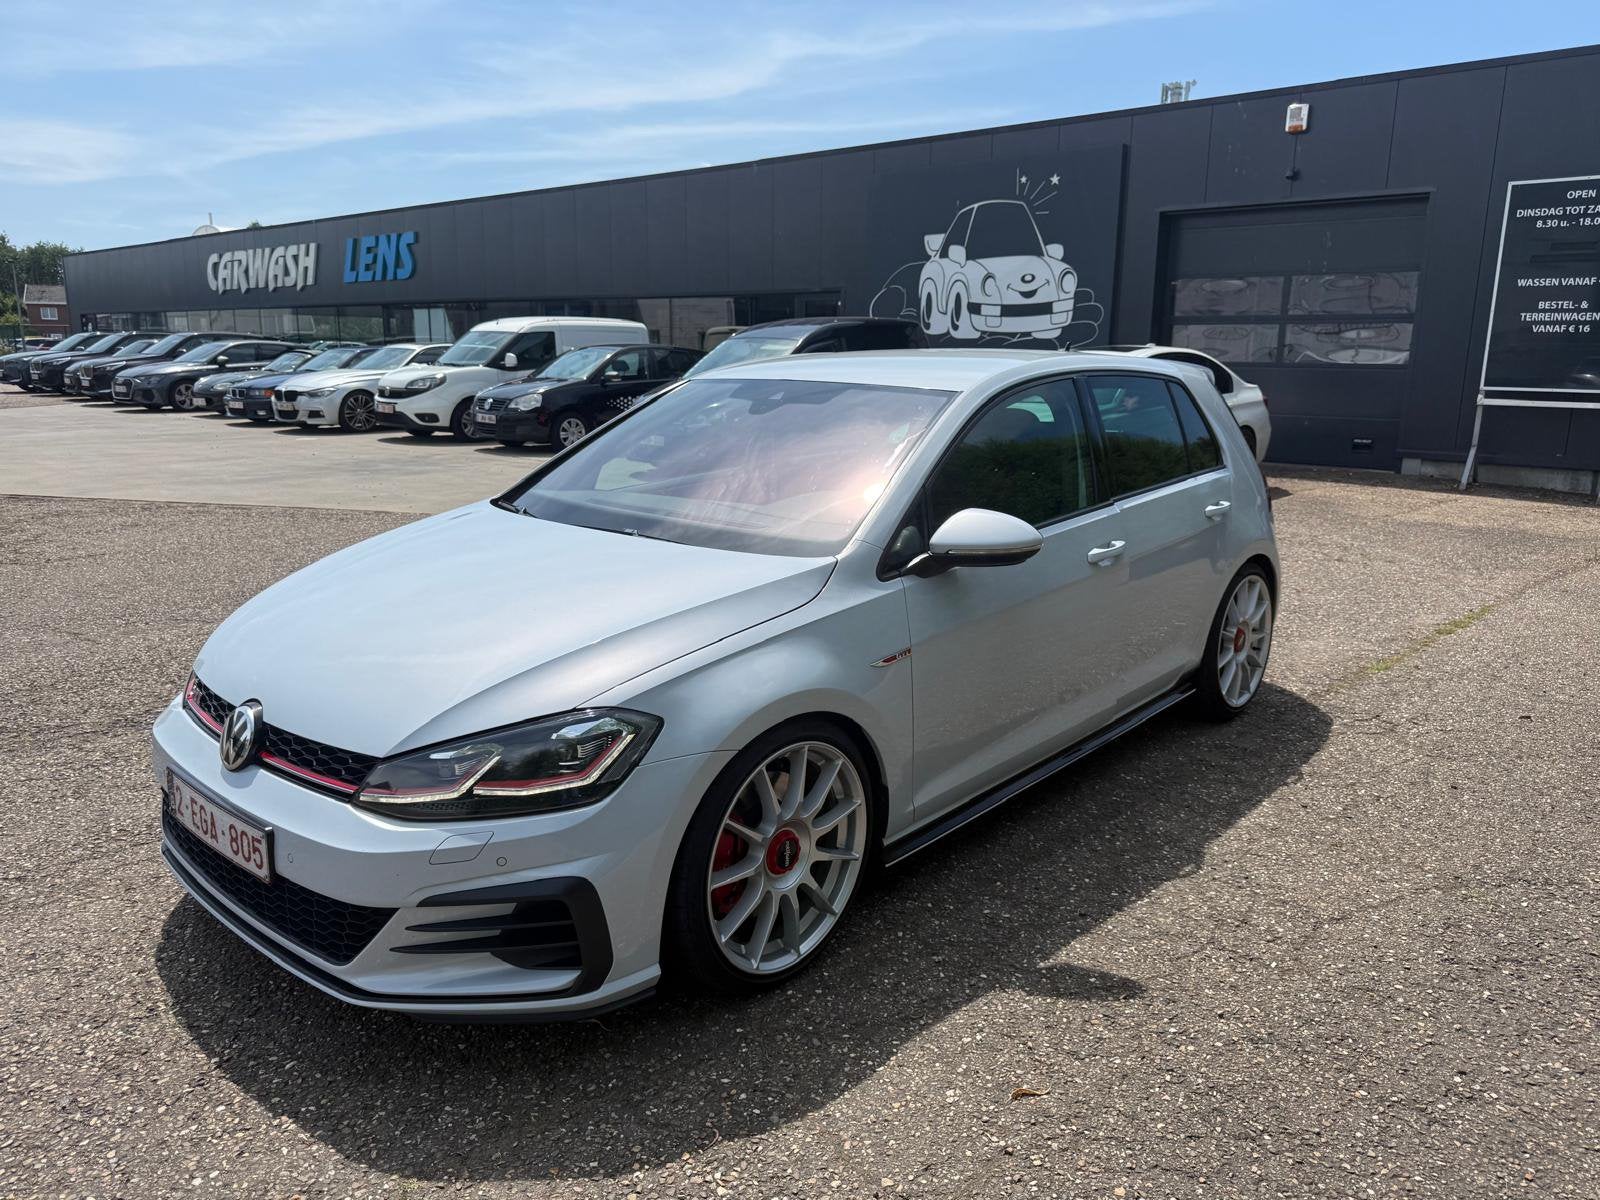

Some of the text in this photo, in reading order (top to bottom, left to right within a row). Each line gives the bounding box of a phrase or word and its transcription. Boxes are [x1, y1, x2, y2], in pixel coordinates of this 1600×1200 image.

[1567, 189, 1597, 199] OPEN
[1516, 207, 1563, 218] DINSDAG
[1565, 205, 1586, 215] TOT
[1536, 219, 1558, 228] 8.30
[206, 231, 417, 295] CARWASH LENS
[1517, 278, 1560, 287] WASSEN
[1561, 277, 1598, 286] VANAF
[1538, 300, 1589, 309] BESTEL- &
[1520, 312, 1600, 321] TERREINWAGEN
[1532, 324, 1567, 333] VANAF
[1578, 324, 1591, 333] 16
